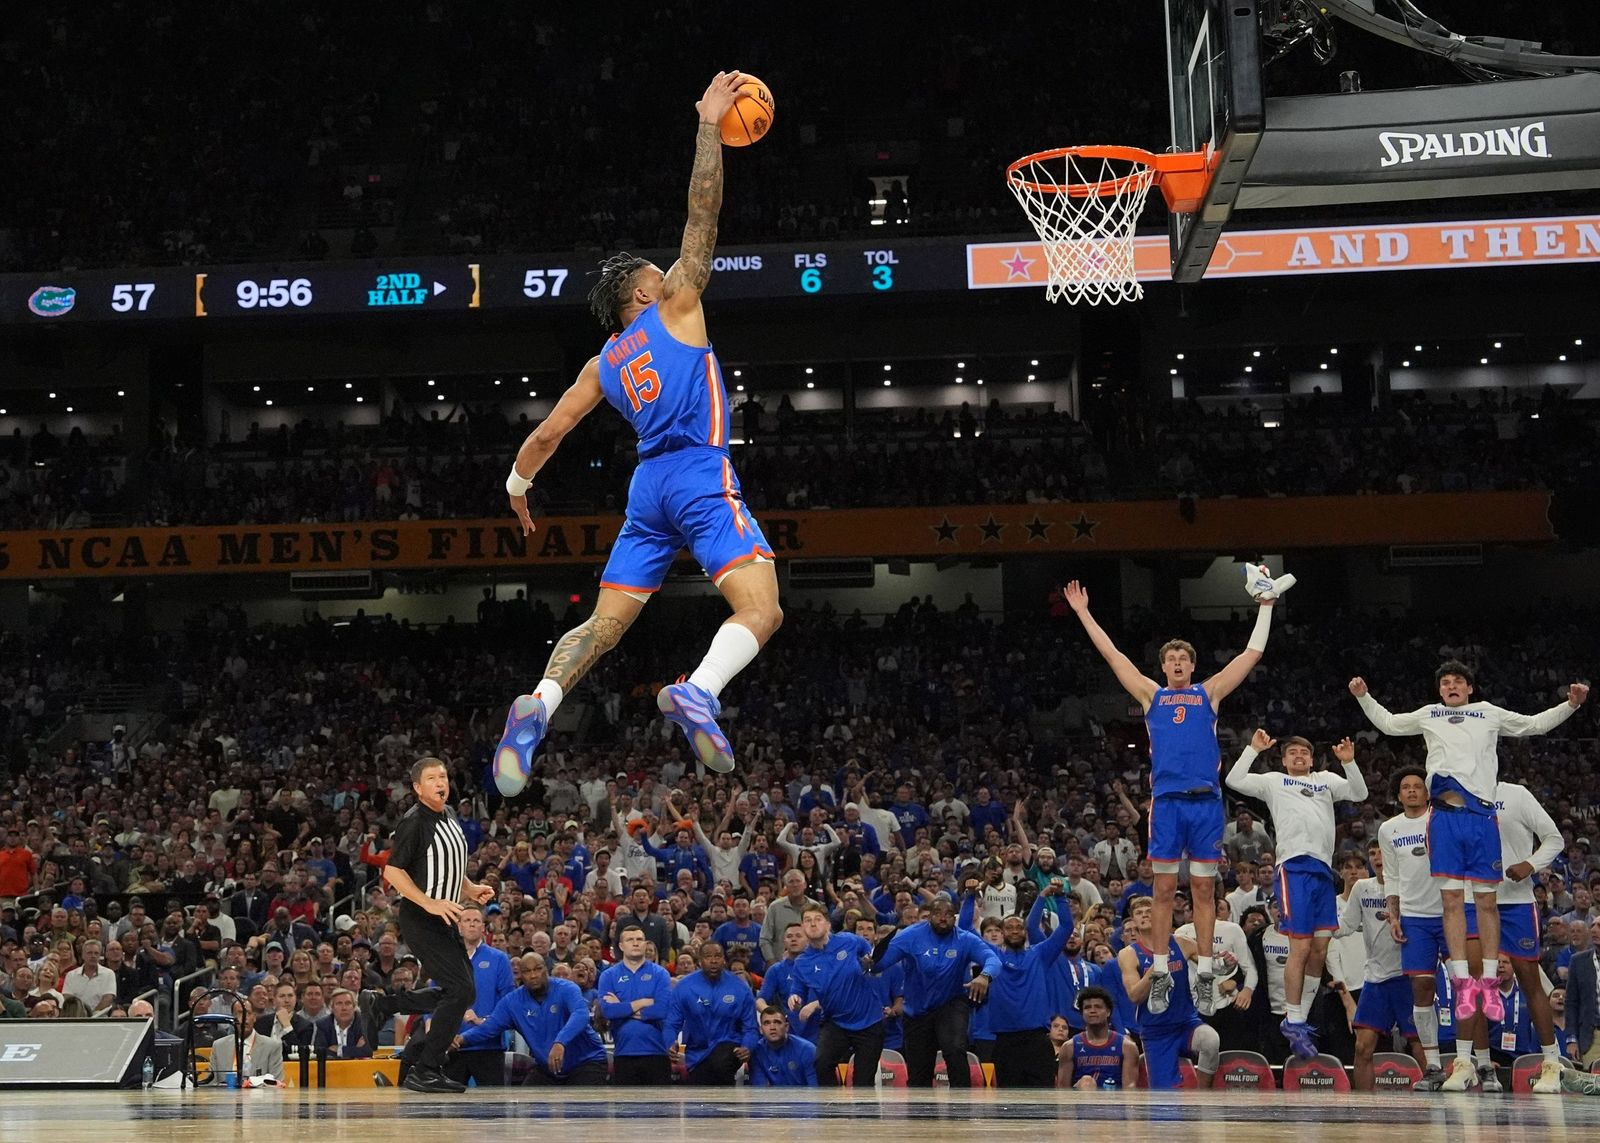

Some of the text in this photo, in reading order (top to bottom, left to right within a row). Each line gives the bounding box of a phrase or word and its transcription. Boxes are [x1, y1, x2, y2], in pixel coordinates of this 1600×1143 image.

[1379, 121, 1552, 168] SPALDING
[864, 250, 899, 265] TOL
[1288, 232, 1409, 267] AND
[711, 255, 763, 272] ONUS
[794, 253, 827, 268] FLS
[376, 273, 421, 290] 2ND
[523, 268, 569, 299] 57
[800, 268, 822, 293] 6
[872, 265, 893, 290] 3
[111, 283, 156, 312] 57
[236, 278, 313, 309] 9:56
[367, 289, 428, 306] HALF
[605, 327, 649, 369] MARTIN
[620, 350, 662, 413] 15
[37, 535, 192, 569] NCAA
[427, 524, 607, 560] FINAL
[1158, 693, 1203, 706] FLORIDA
[1172, 705, 1187, 724] 3
[1392, 833, 1425, 848] NOTHING
[1361, 897, 1387, 909] NOTHING
[1224, 1073, 1259, 1083] FINAL FOUR
[1299, 1076, 1335, 1086] FINAL FOUR
[1374, 1076, 1411, 1086] FINAL FOUR
